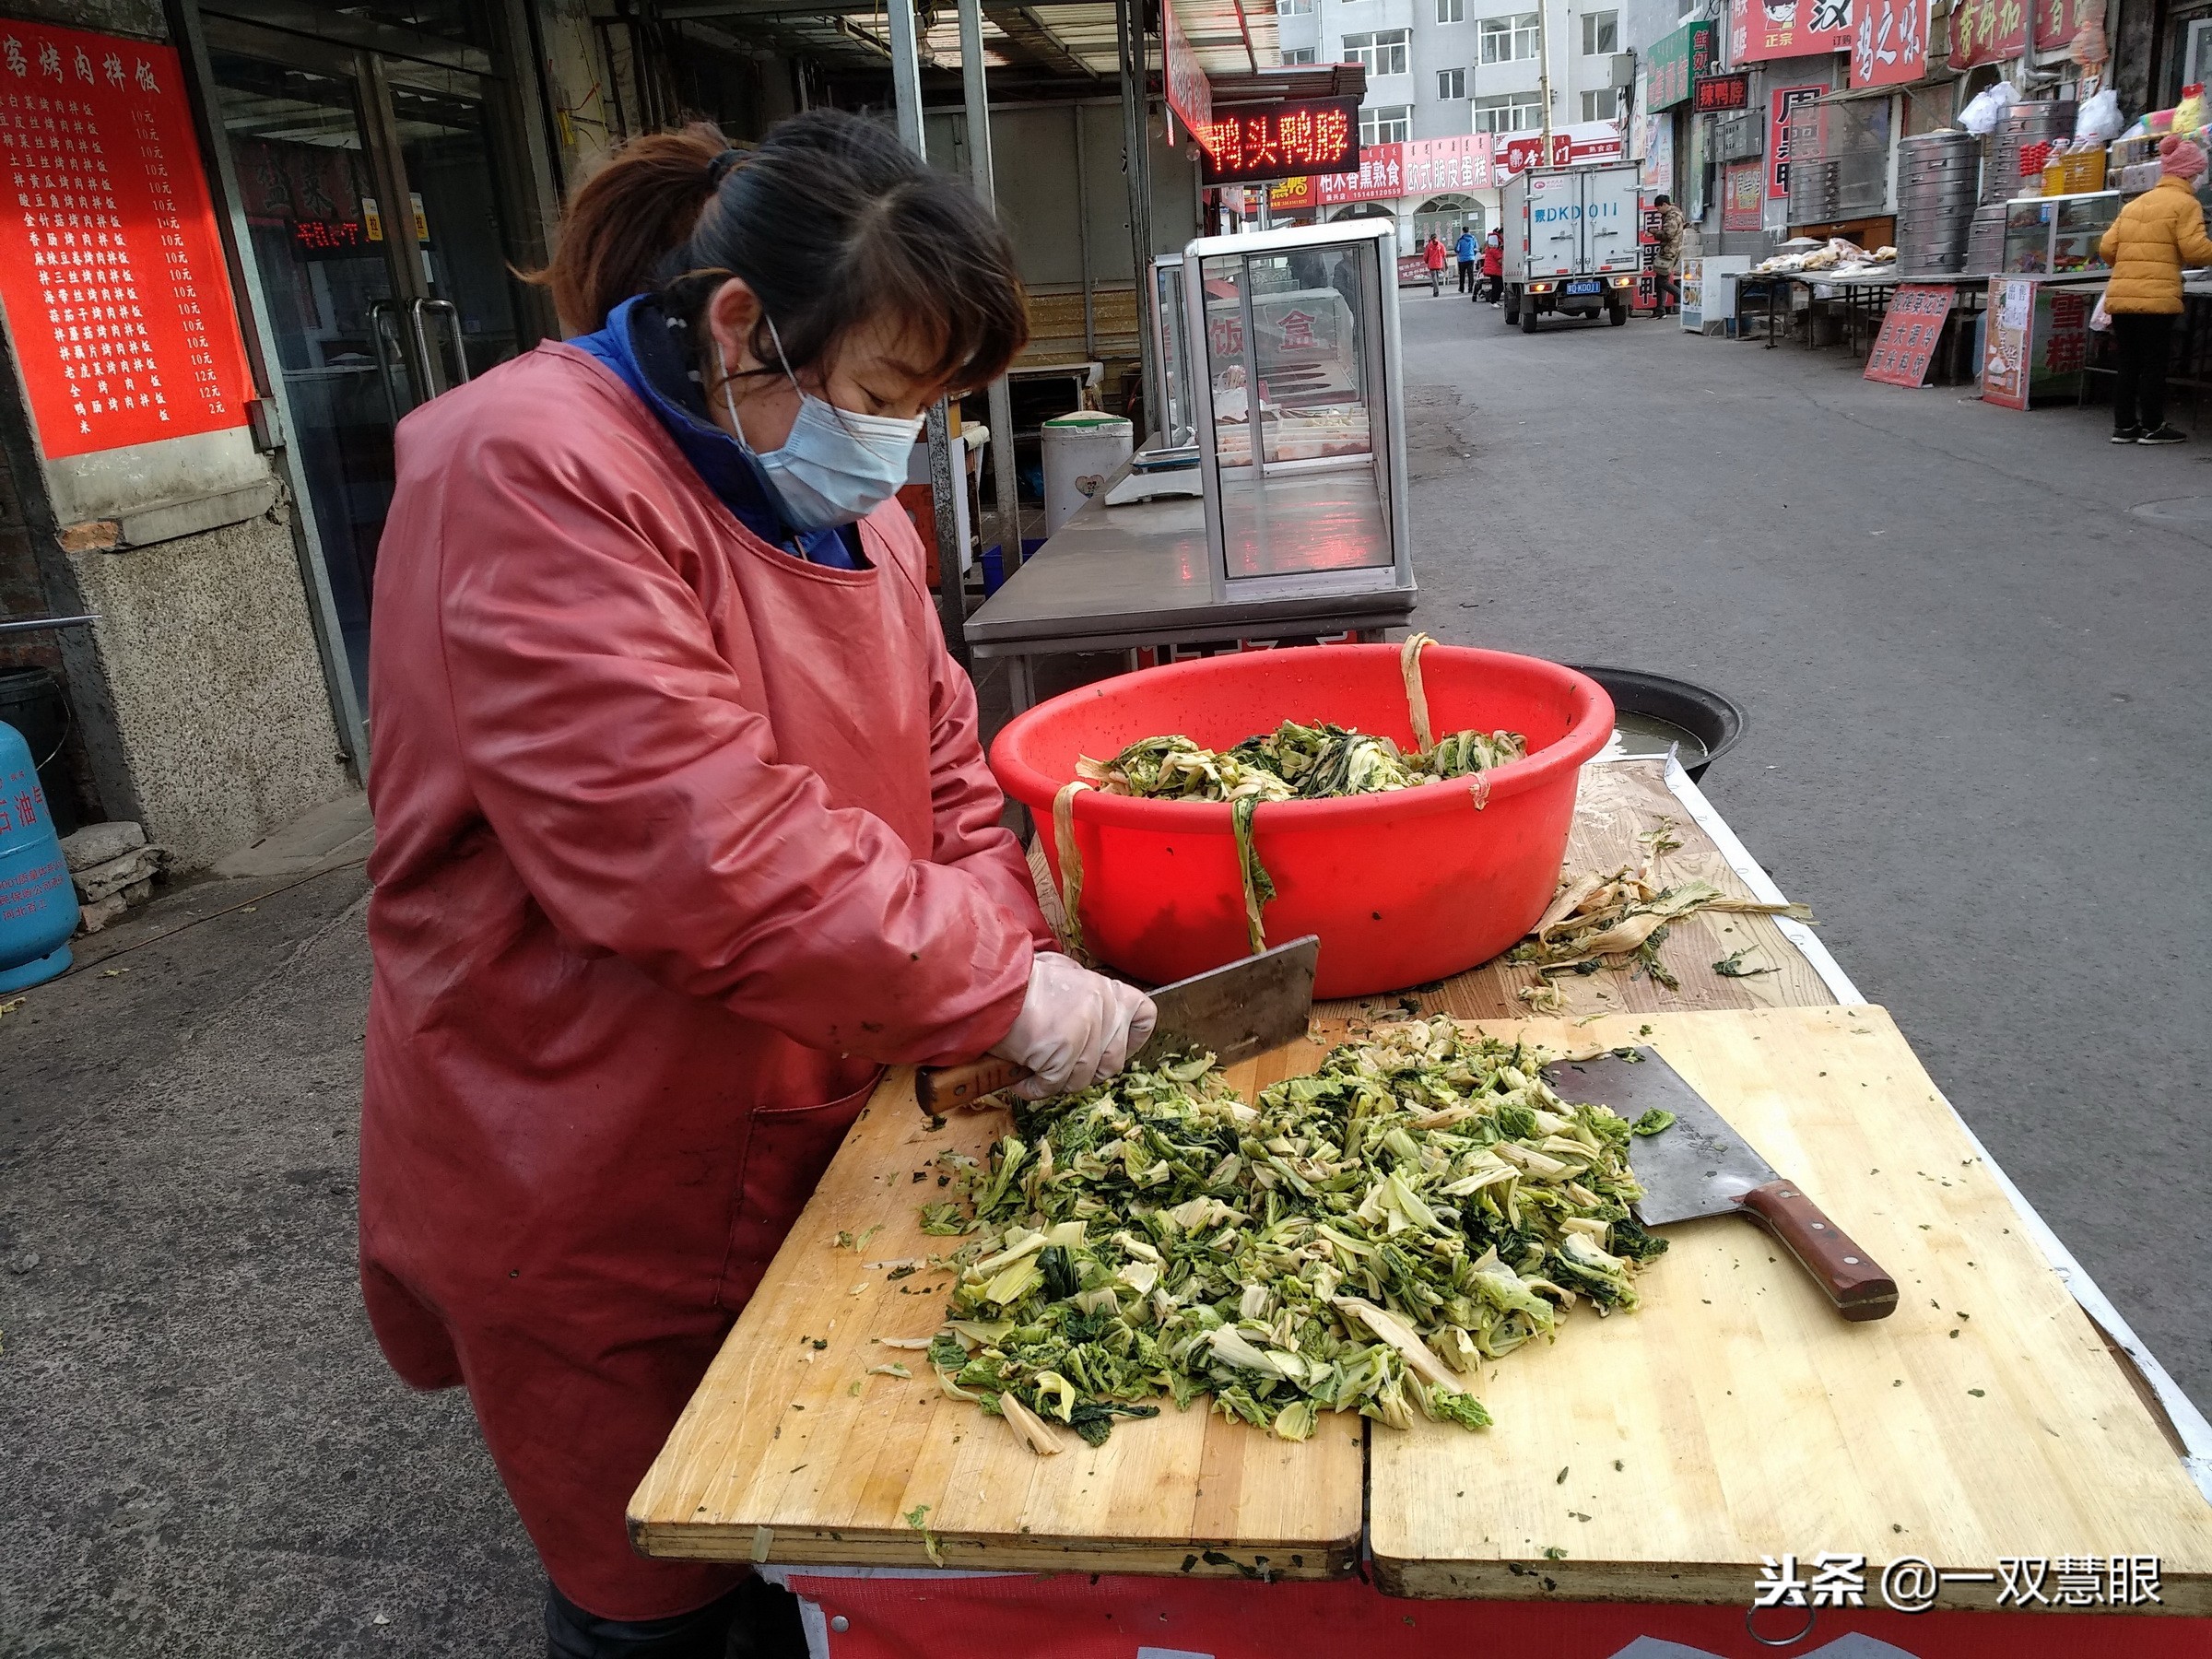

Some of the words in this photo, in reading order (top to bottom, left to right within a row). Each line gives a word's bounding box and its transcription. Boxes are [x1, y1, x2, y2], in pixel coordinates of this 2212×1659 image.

[1765, 33, 1794, 48] 正宗
[3, 33, 161, 95] 客烤肉拌饭
[0, 93, 94, 117] 白菜烤肉拌饭
[1700, 81, 1745, 106] 辣鸭脖
[3, 132, 103, 155] 榨菜丝烤肉拌饭
[140, 147, 164, 159] 10元
[1211, 109, 1347, 171] 鸭头鸭脖
[10, 152, 108, 173] 土豆丝烤肉拌饭
[145, 164, 168, 177] 10元
[1406, 155, 1488, 192] 欧式脆皮蛋糕
[13, 172, 112, 192] 拌黄瓜烤肉拌饭
[148, 182, 172, 194] 10元
[1353, 188, 1402, 199] 15148120559
[18, 192, 117, 211] 酸豆角烤肉拌饭
[152, 199, 176, 212] 10元
[23, 211, 122, 229] 金针菇烤肉拌饭
[29, 231, 126, 248] 香肠烤肉拌饭
[160, 233, 184, 247] 10元
[34, 250, 130, 267] 麻辣豆卷烤肉拌饭
[165, 250, 188, 264] 10元
[38, 269, 135, 286] 拌三丝烤肉拌饭
[169, 267, 193, 281] 10元
[43, 286, 139, 305] 海带丝烤肉拌饭
[173, 284, 196, 299] 10元
[49, 303, 143, 324] 蒜茄子烤肉拌饭
[178, 300, 201, 315] 10元
[53, 322, 147, 343] 拌蘑菇烤肉拌饭
[182, 318, 205, 332] 10元
[2046, 291, 2085, 372] 雪糕
[59, 339, 153, 361] 拌藕片烤肉拌饭
[186, 335, 209, 348] 10元
[65, 357, 158, 380] 老虎菜烤肉拌饭
[191, 351, 213, 366] 10元
[70, 374, 162, 399] 全烤肉饭
[194, 368, 217, 382] 12元
[74, 391, 167, 417] 鸭肠烤肉拌饭
[199, 384, 221, 399] 12元
[79, 408, 171, 435] 米饭
[208, 401, 226, 415] 2元
